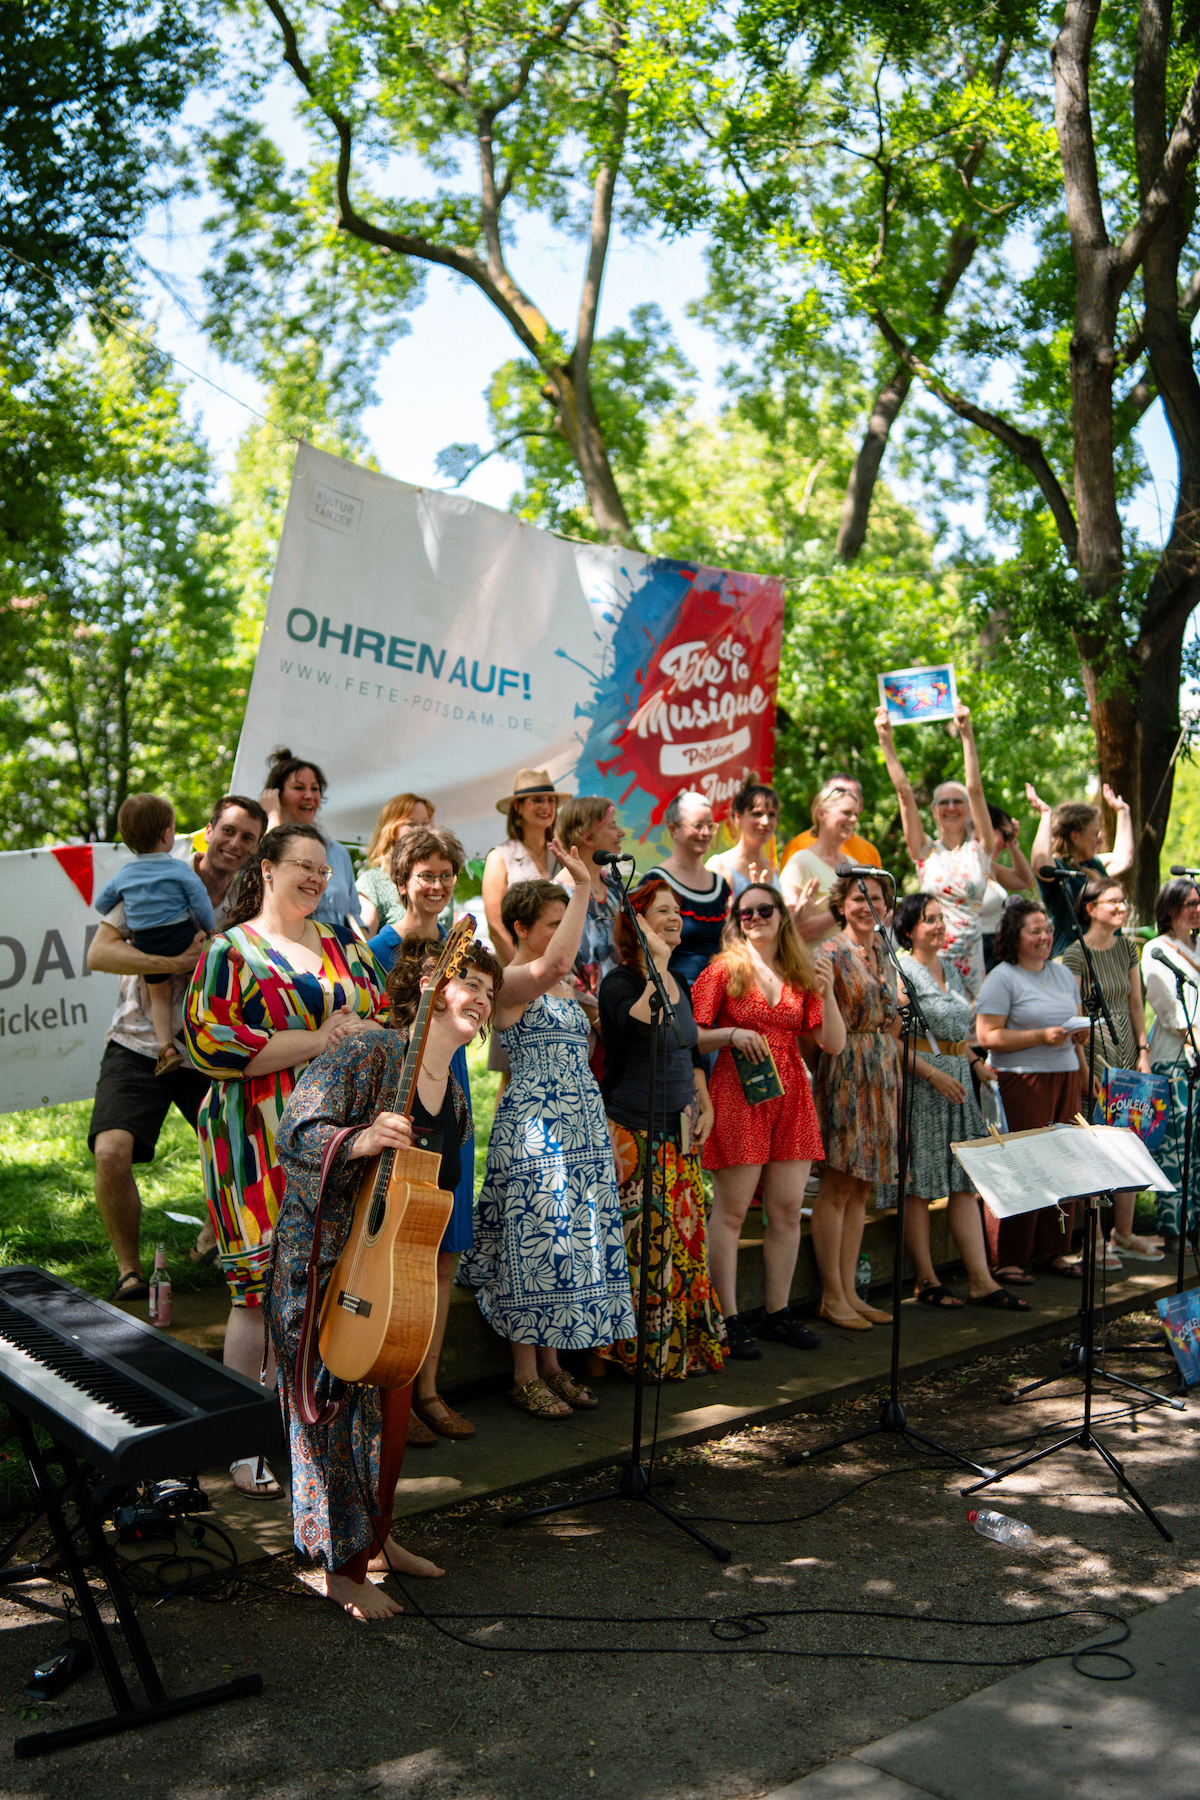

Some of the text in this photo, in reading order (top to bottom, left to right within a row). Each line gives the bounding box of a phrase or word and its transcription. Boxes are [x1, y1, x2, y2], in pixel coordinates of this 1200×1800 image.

[316, 490, 355, 515] KULTUR
[286, 607, 532, 700] OHREN AUF!
[717, 633, 747, 661] de
[731, 657, 750, 683] la
[279, 658, 533, 732] WWW.FETE-POTSDAM.DE
[627, 685, 769, 742] Musique
[682, 741, 734, 767] Potsdam
[0, 924, 100, 990] DA
[0, 998, 88, 1037] ickeln
[1109, 1098, 1155, 1119] COULEURS
